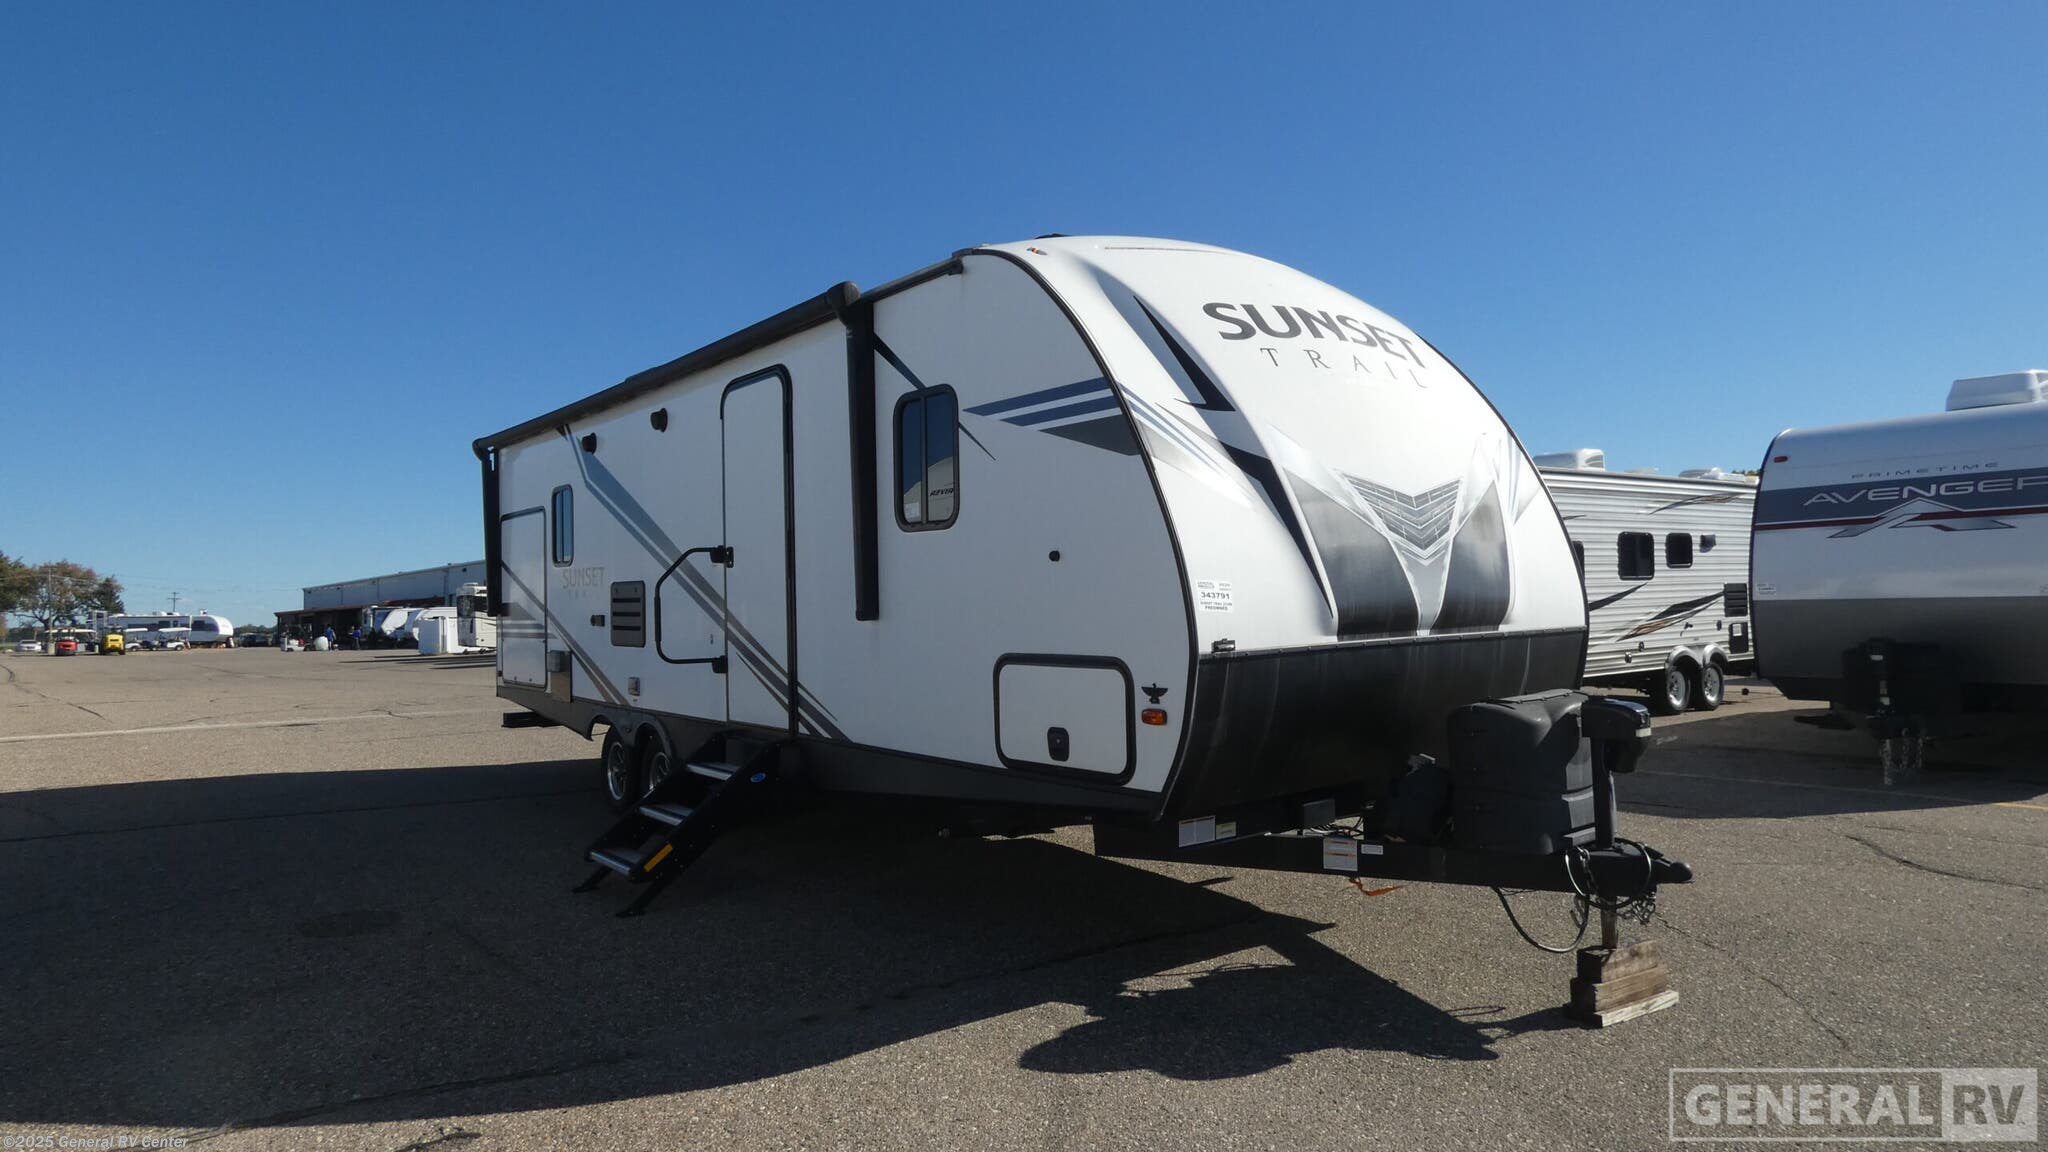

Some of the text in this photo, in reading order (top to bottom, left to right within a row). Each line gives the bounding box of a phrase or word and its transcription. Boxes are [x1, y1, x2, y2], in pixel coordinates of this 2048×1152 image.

[1202, 302, 1426, 368] SUNSET
[1260, 347, 1428, 389] TRAIL
[1851, 462, 1999, 479] PRIMETIME
[562, 566, 605, 589] SUNSET
[1200, 592, 1230, 600] 343791
